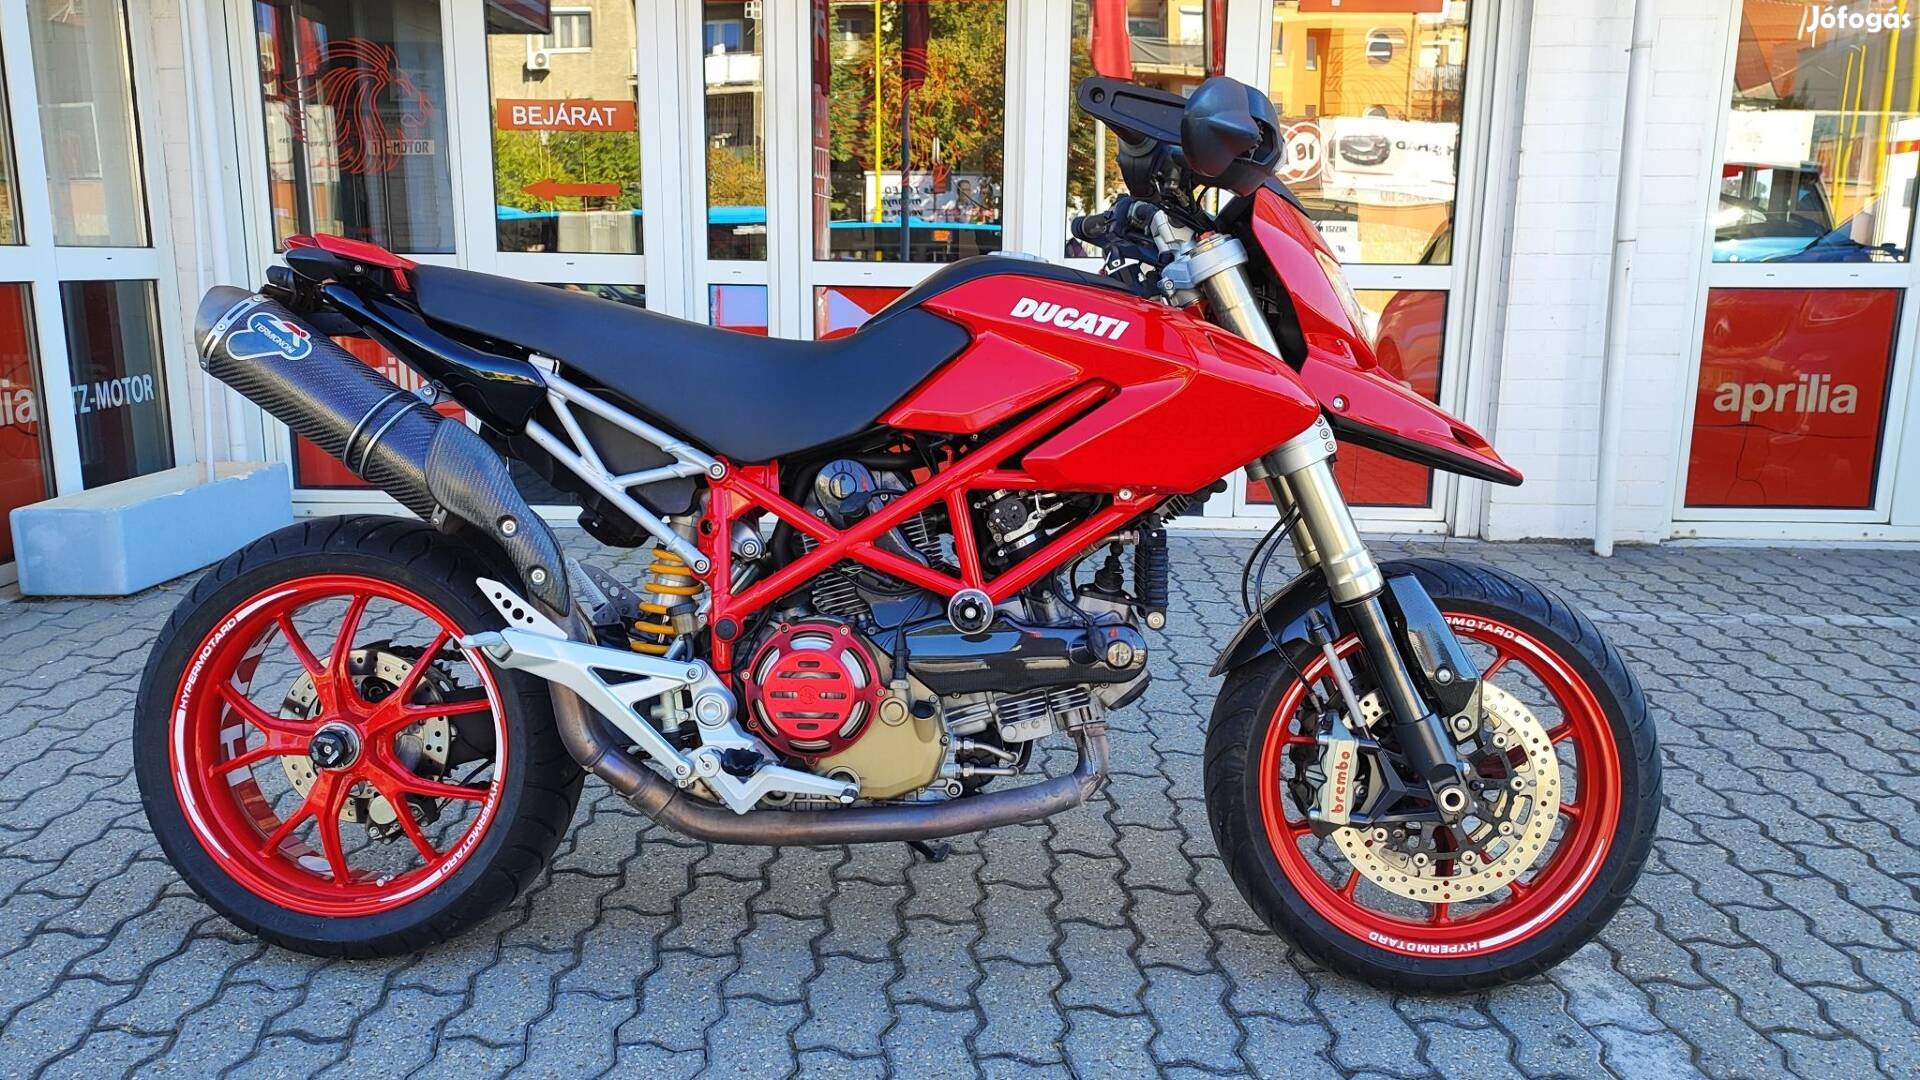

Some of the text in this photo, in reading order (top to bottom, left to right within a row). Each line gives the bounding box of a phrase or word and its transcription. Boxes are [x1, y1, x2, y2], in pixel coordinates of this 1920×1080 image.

[512, 103, 617, 126] BEJÁRAT
[255, 322, 297, 354] TERMIGNONI
[1010, 297, 1130, 340] DUCATI
[1713, 373, 1858, 422] aprilia
[179, 617, 237, 709] HYPERMOTARD
[1331, 751, 1351, 813] brembo
[441, 782, 499, 874] HYPERMOTARD
[1368, 931, 1478, 954] HYPERMOTARD
